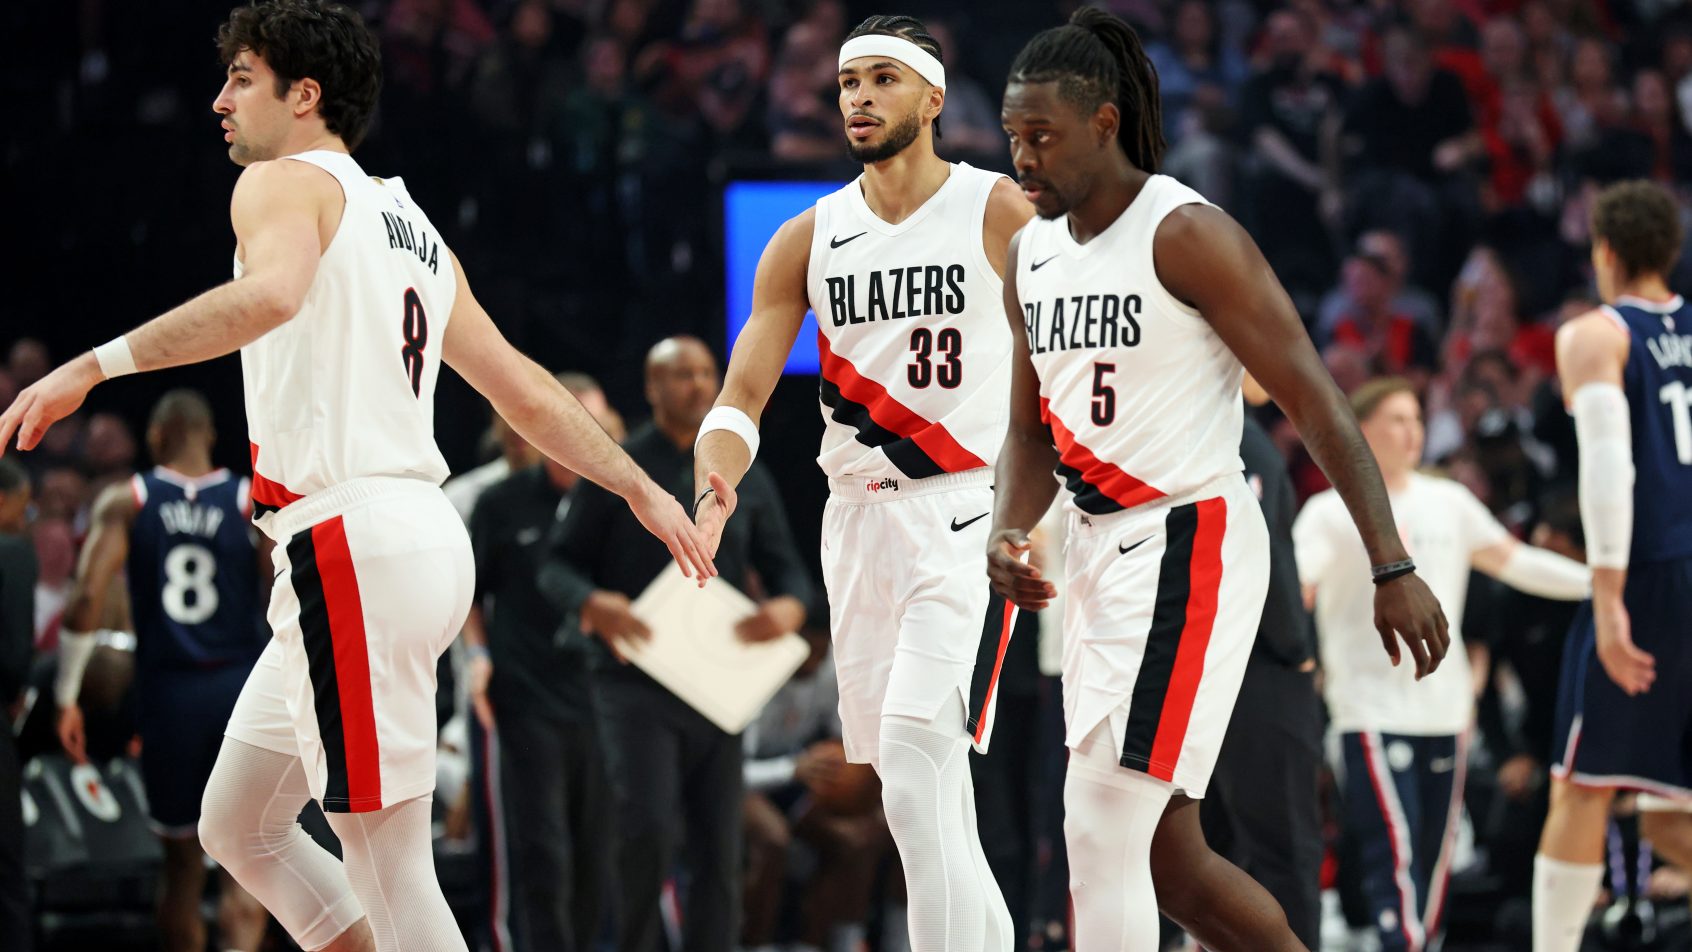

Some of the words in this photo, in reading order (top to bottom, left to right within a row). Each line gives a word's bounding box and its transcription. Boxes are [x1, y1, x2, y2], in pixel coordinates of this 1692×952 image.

[825, 264, 965, 327] BLAZERS
[1024, 294, 1142, 354] BLAZERS
[402, 287, 428, 400] 8
[907, 327, 962, 389] 33
[1090, 361, 1116, 427] 5
[1659, 380, 1692, 465] 1
[162, 543, 219, 624] 8
